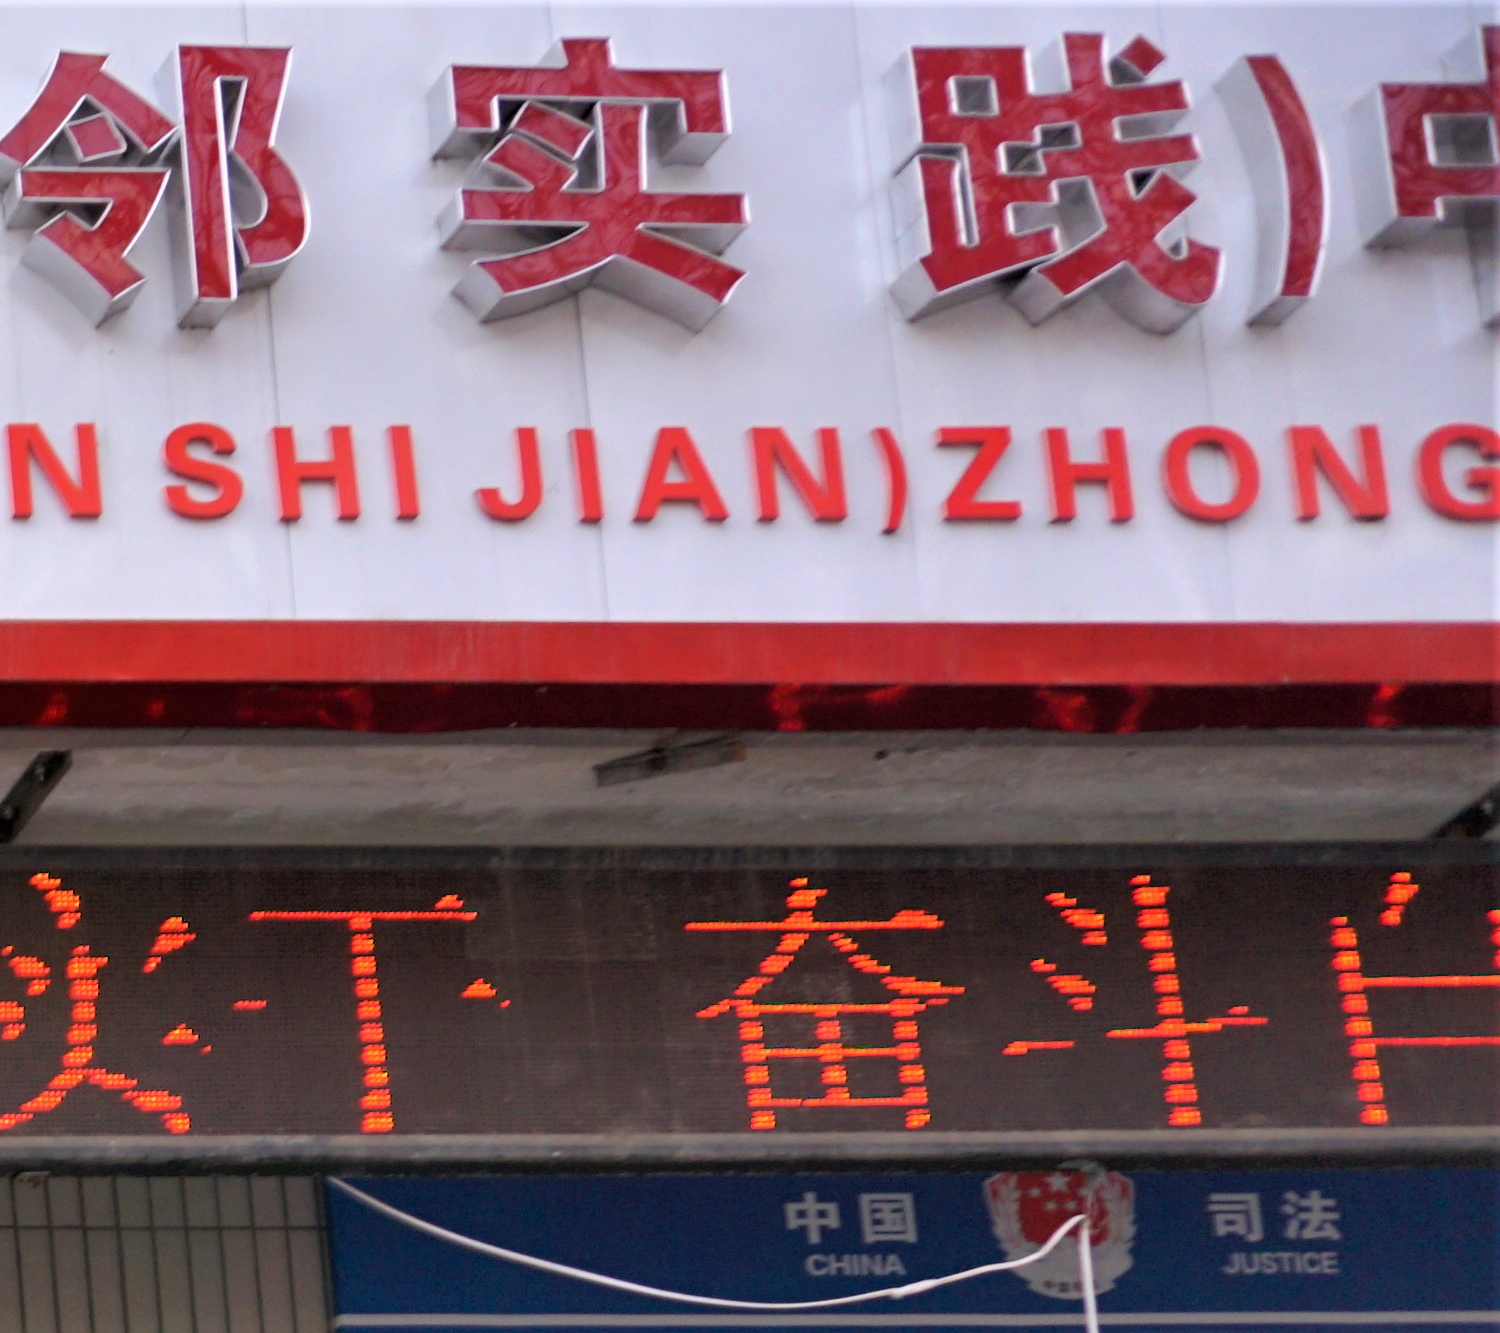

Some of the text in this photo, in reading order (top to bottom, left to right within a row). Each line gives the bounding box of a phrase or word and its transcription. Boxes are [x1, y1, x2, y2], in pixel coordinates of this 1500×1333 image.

[164, 423, 419, 522] SHI
[784, 1191, 1345, 1245] 中国 司法
[804, 1251, 1340, 1277] CHINA JUSTICE
